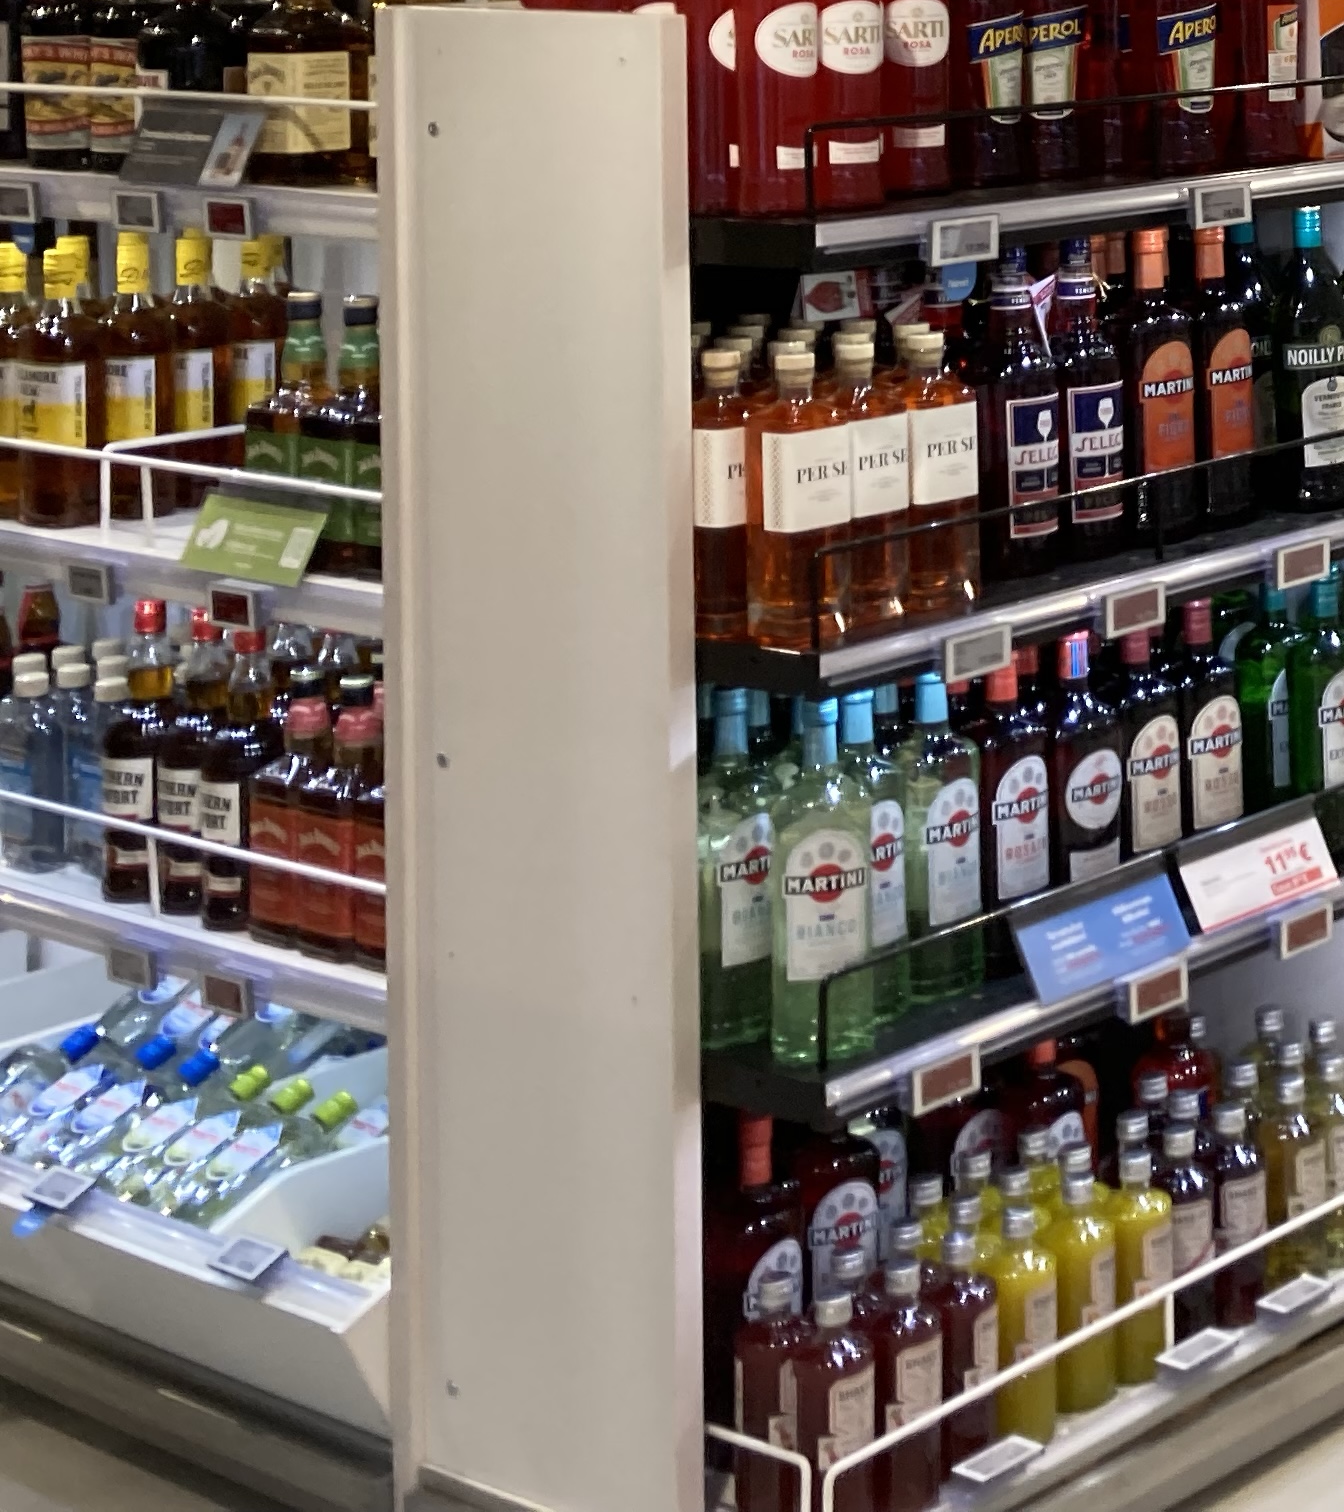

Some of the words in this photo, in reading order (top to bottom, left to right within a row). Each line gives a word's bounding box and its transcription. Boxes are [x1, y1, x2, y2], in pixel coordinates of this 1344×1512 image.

[886, 20, 944, 41] SARTI
[843, 46, 871, 56] ROSA
[903, 39, 932, 50] ROSA
[1287, 345, 1335, 367] NOILLY
[927, 440, 958, 459] PER
[859, 452, 892, 472] PER
[797, 465, 828, 485] PER
[787, 871, 864, 894] MARTINI
